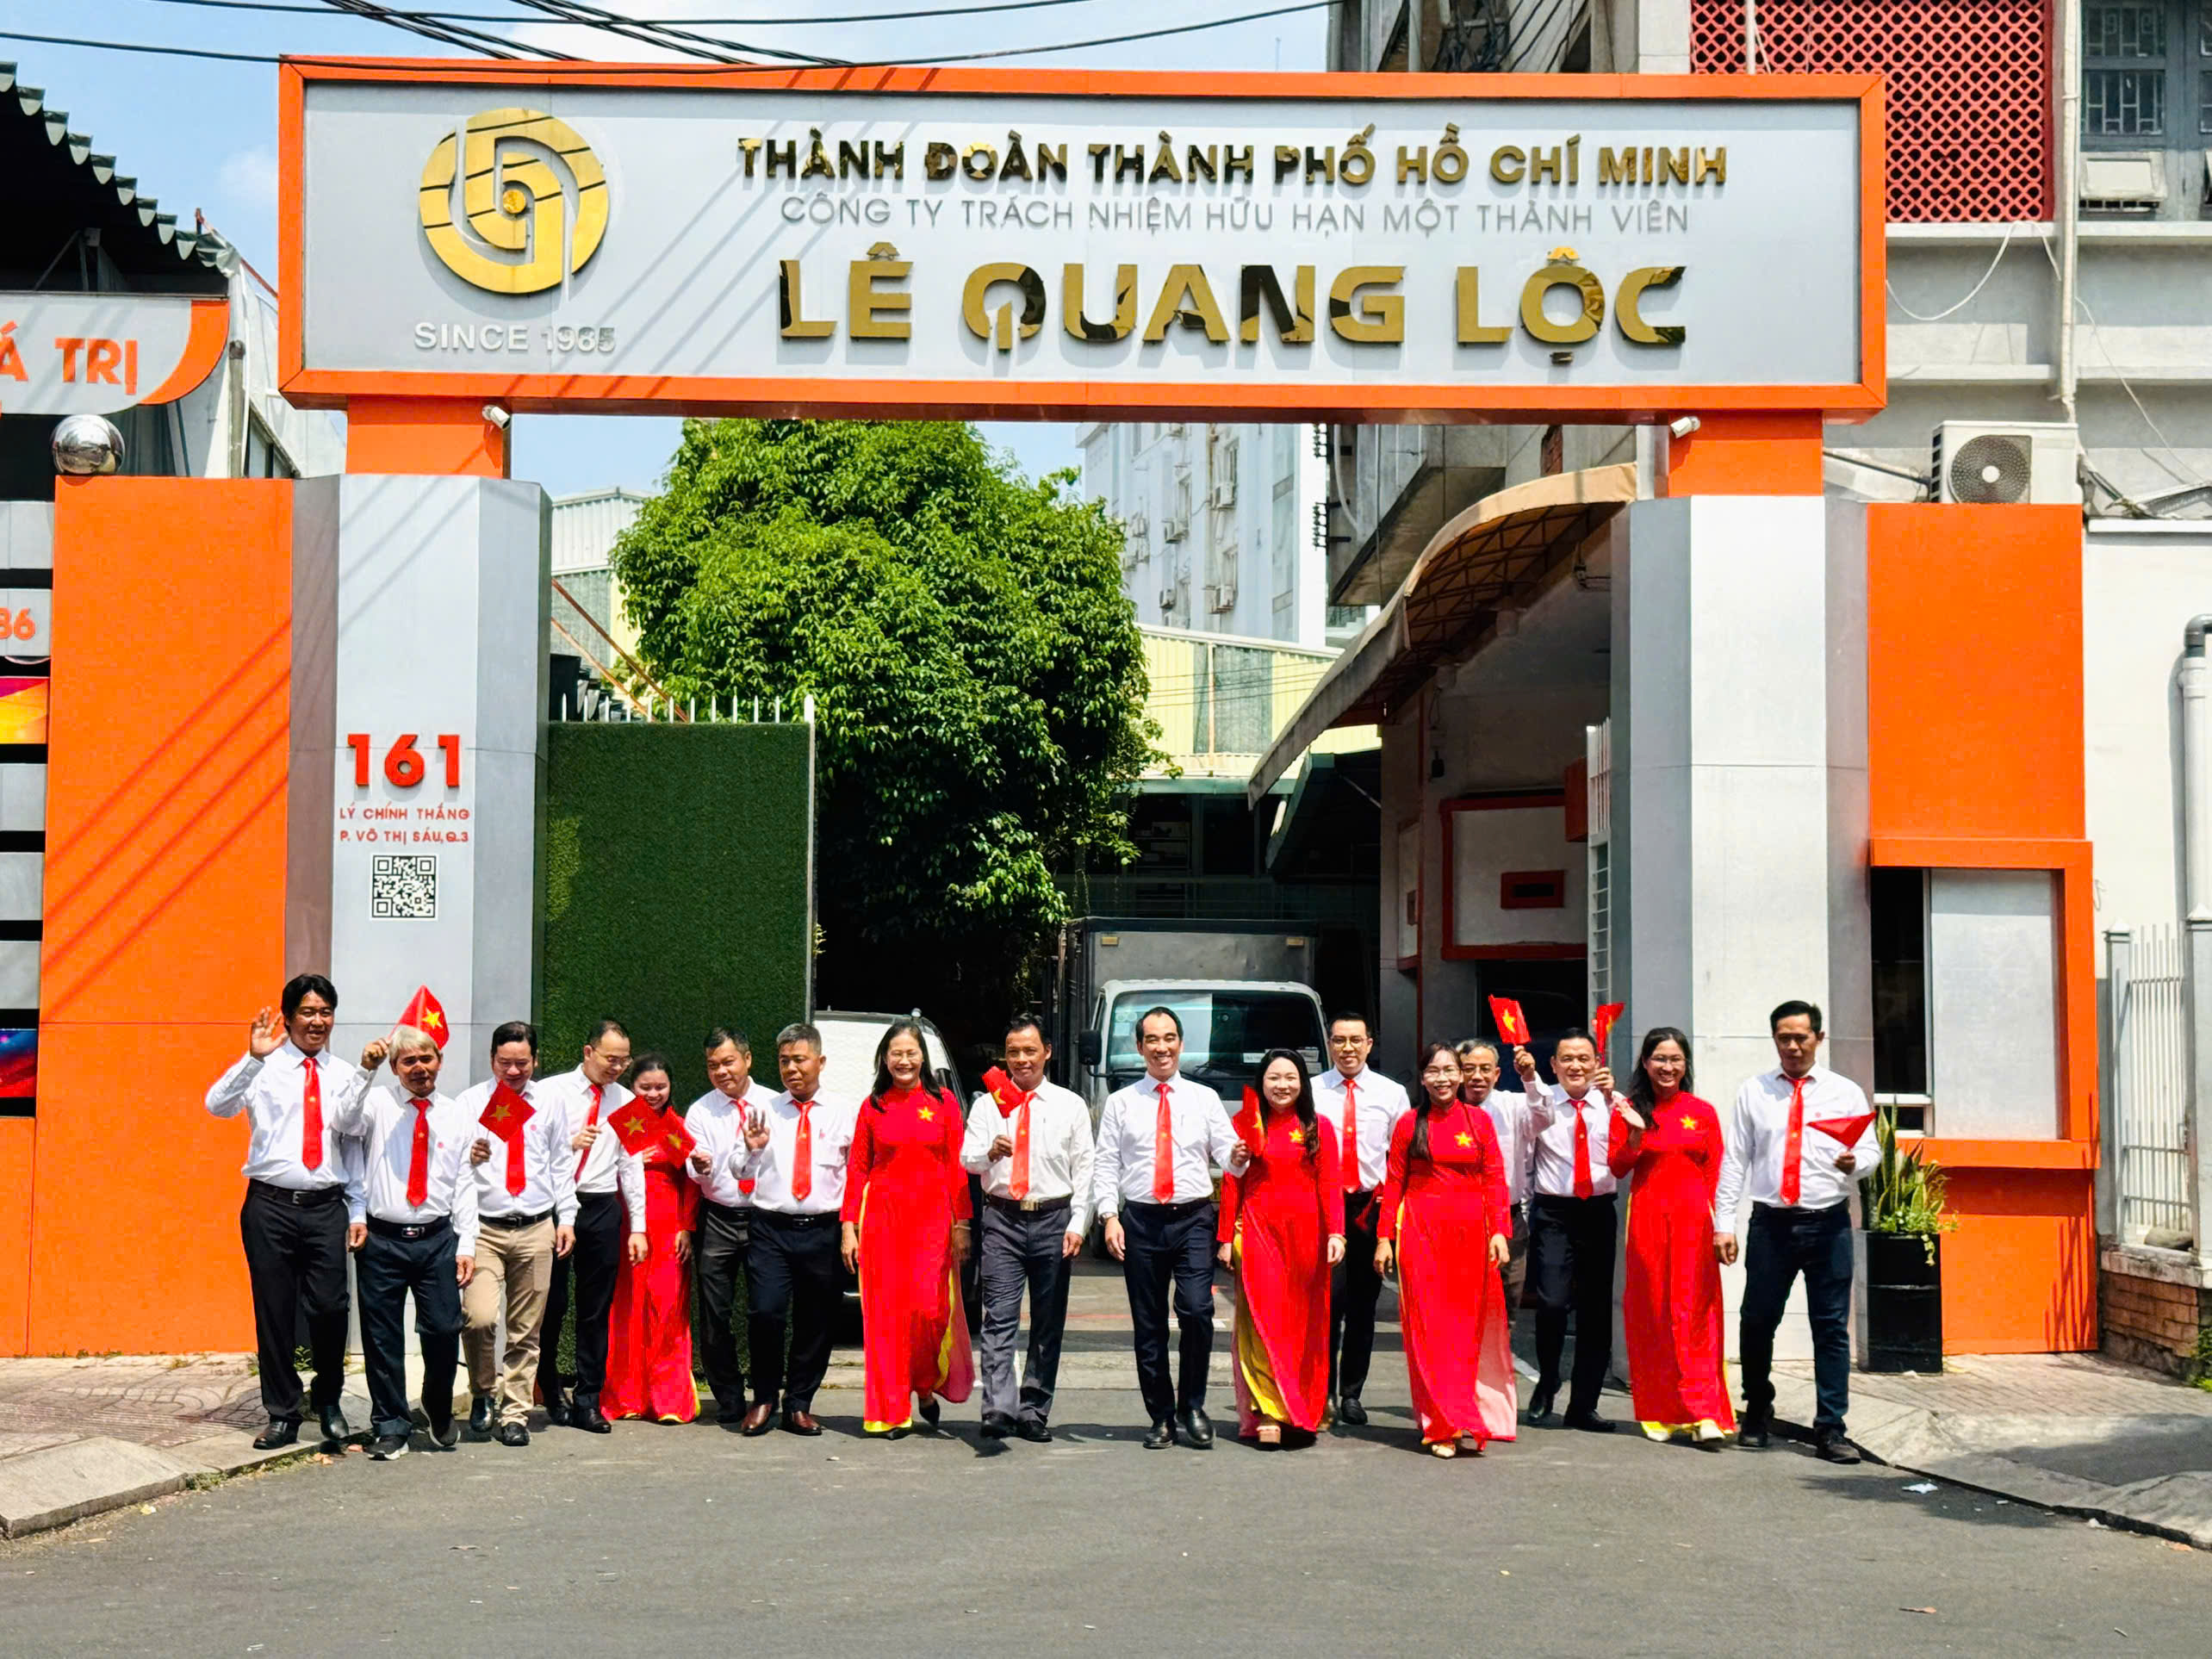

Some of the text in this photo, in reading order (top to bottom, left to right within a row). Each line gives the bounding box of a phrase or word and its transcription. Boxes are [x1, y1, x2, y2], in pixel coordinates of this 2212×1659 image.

[738, 122, 1727, 186] THÀNH ĐOÀN THÀNH PHỐ HỒ CHÍ MINH
[780, 192, 1688, 238] CÔNG TY TRÁCH NHIỆM HỮU HẠN MỘT THÀNH VIÊN
[779, 241, 1687, 365] LÊ QUANG LỘC
[413, 321, 529, 351] SINCE
[347, 733, 461, 788] 161
[339, 801, 356, 820] LÝ
[363, 801, 408, 821] CHÍNH
[339, 830, 351, 842] P.
[356, 828, 378, 842] VÕ
